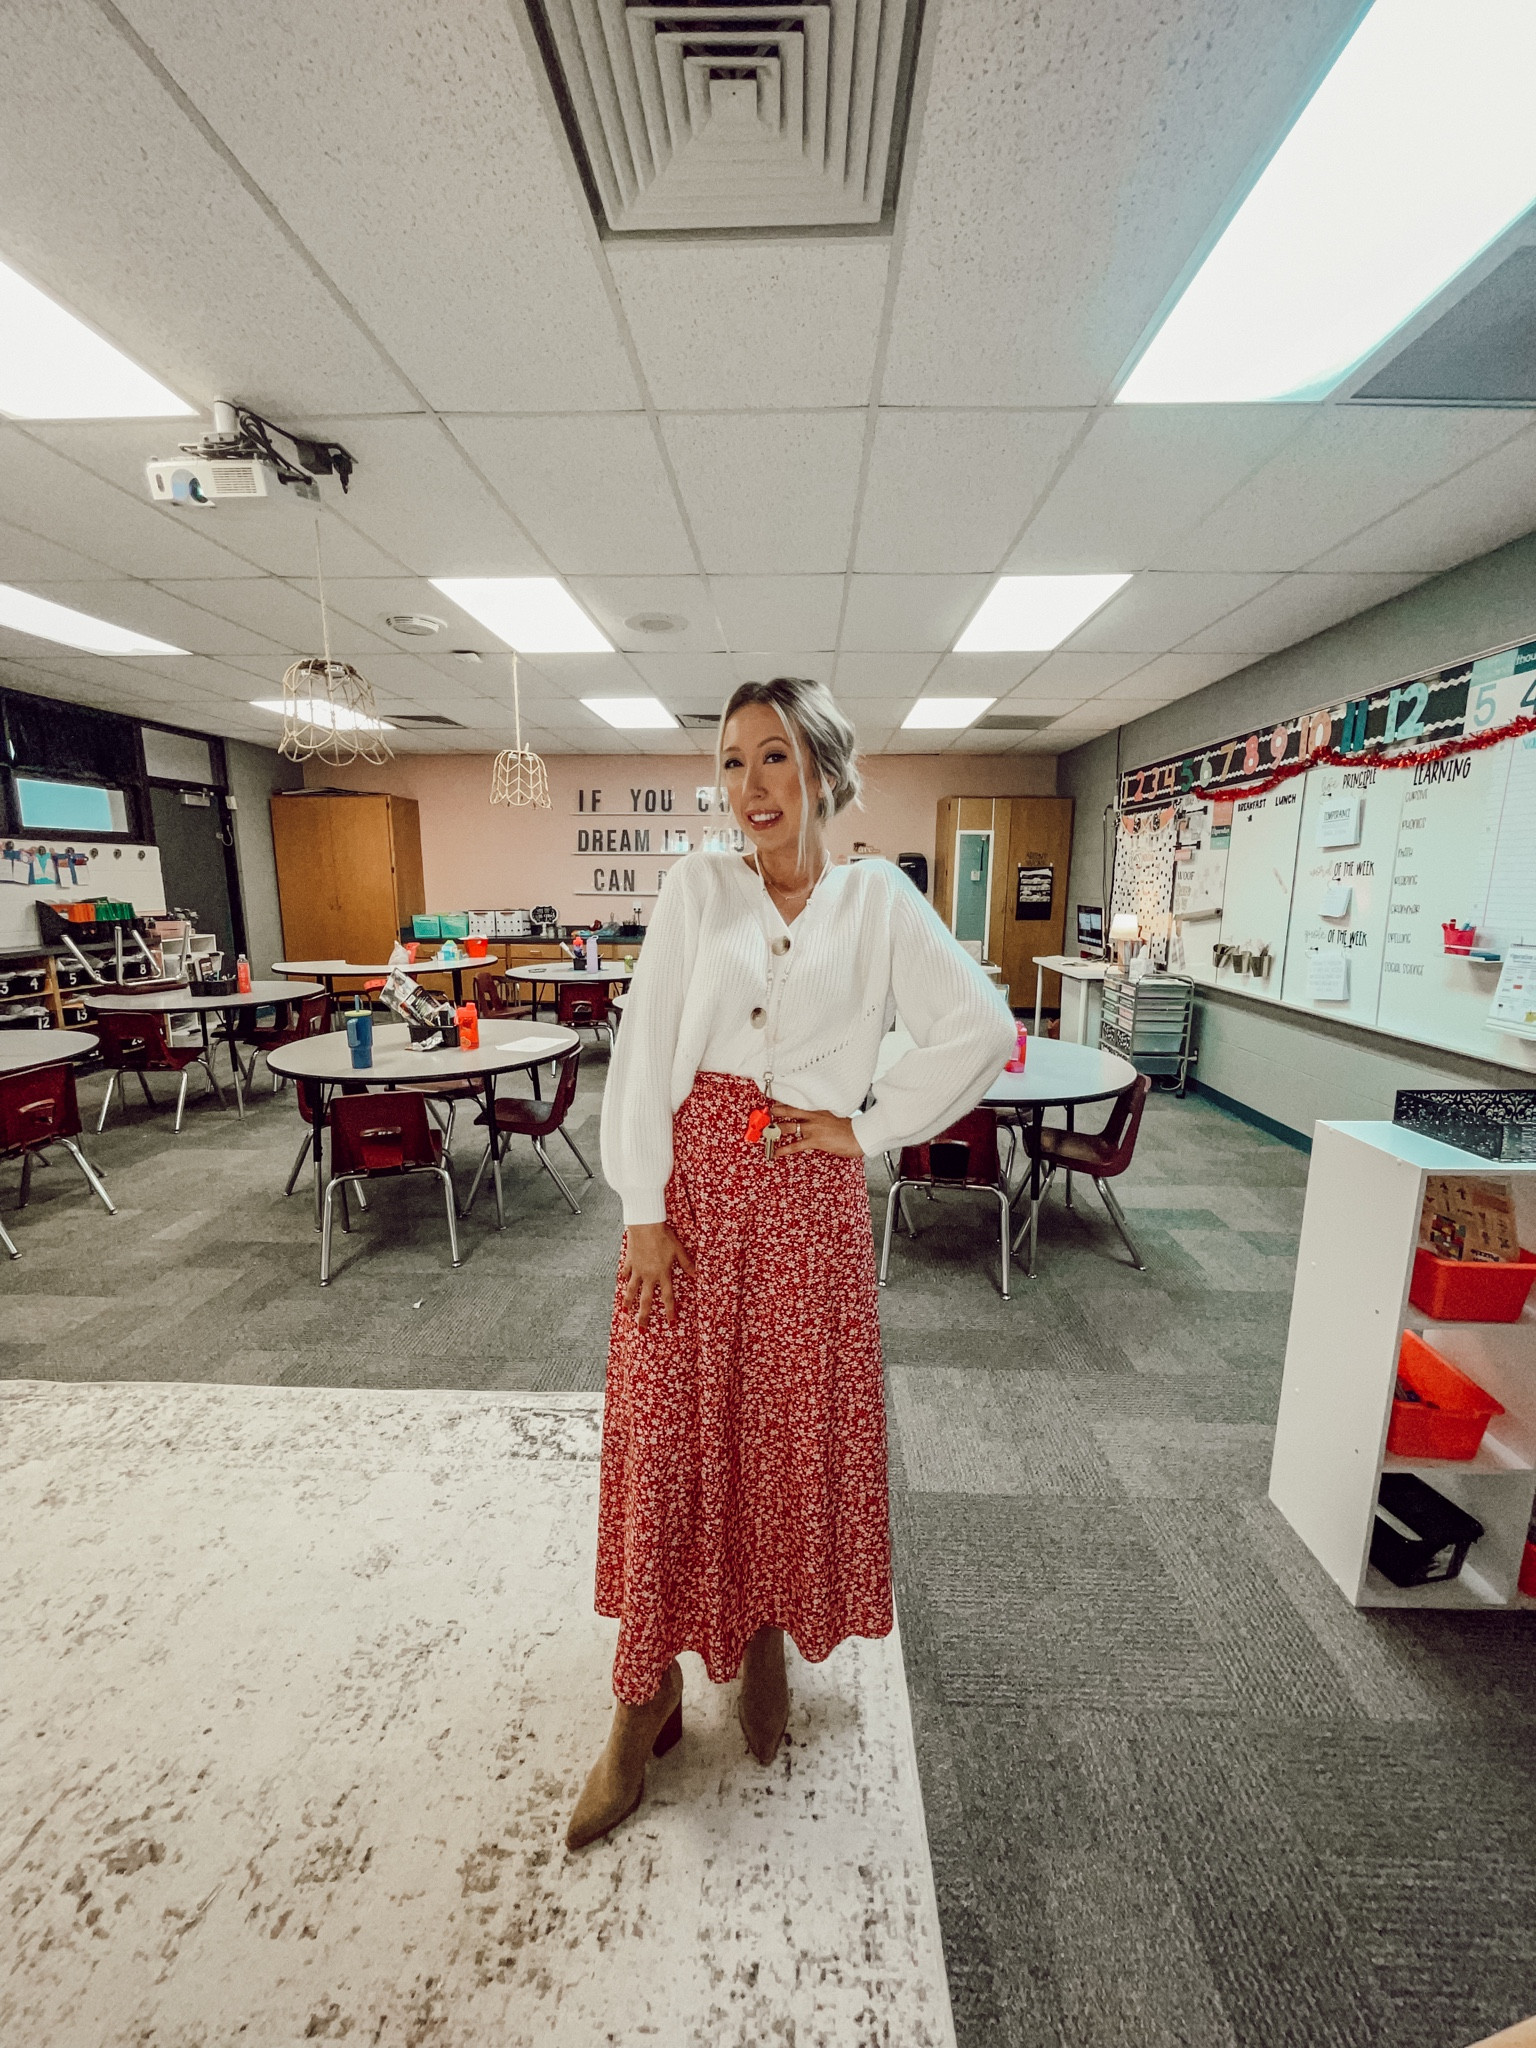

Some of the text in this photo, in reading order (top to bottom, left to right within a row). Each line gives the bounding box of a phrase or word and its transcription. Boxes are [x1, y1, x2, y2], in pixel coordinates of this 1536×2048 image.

[1473, 683, 1497, 727] 5
[1123, 682, 1429, 805] 1 2 3 4 5 6 7 8 9 10 11 12
[1342, 768, 1377, 789] PRINCIPLE
[1413, 757, 1472, 786] LEARNING
[578, 789, 602, 812] IF
[630, 789, 673, 812] YOU
[1238, 794, 1297, 812] BREAKFAST LUNCH
[577, 829, 650, 852] DREAM
[664, 829, 695, 852] IT,
[1178, 871, 1195, 880] WOOF
[1334, 862, 1342, 876] OF
[1343, 861, 1354, 876] THE
[1356, 860, 1375, 876] WEEK
[593, 868, 636, 892] CAN
[1328, 929, 1336, 943] OF
[1337, 929, 1348, 945] THE
[1349, 930, 1368, 947] WEEK
[140, 964, 147, 975] 8
[0, 980, 9, 994] 3
[30, 978, 39, 991] 4
[69, 973, 77, 985] 5
